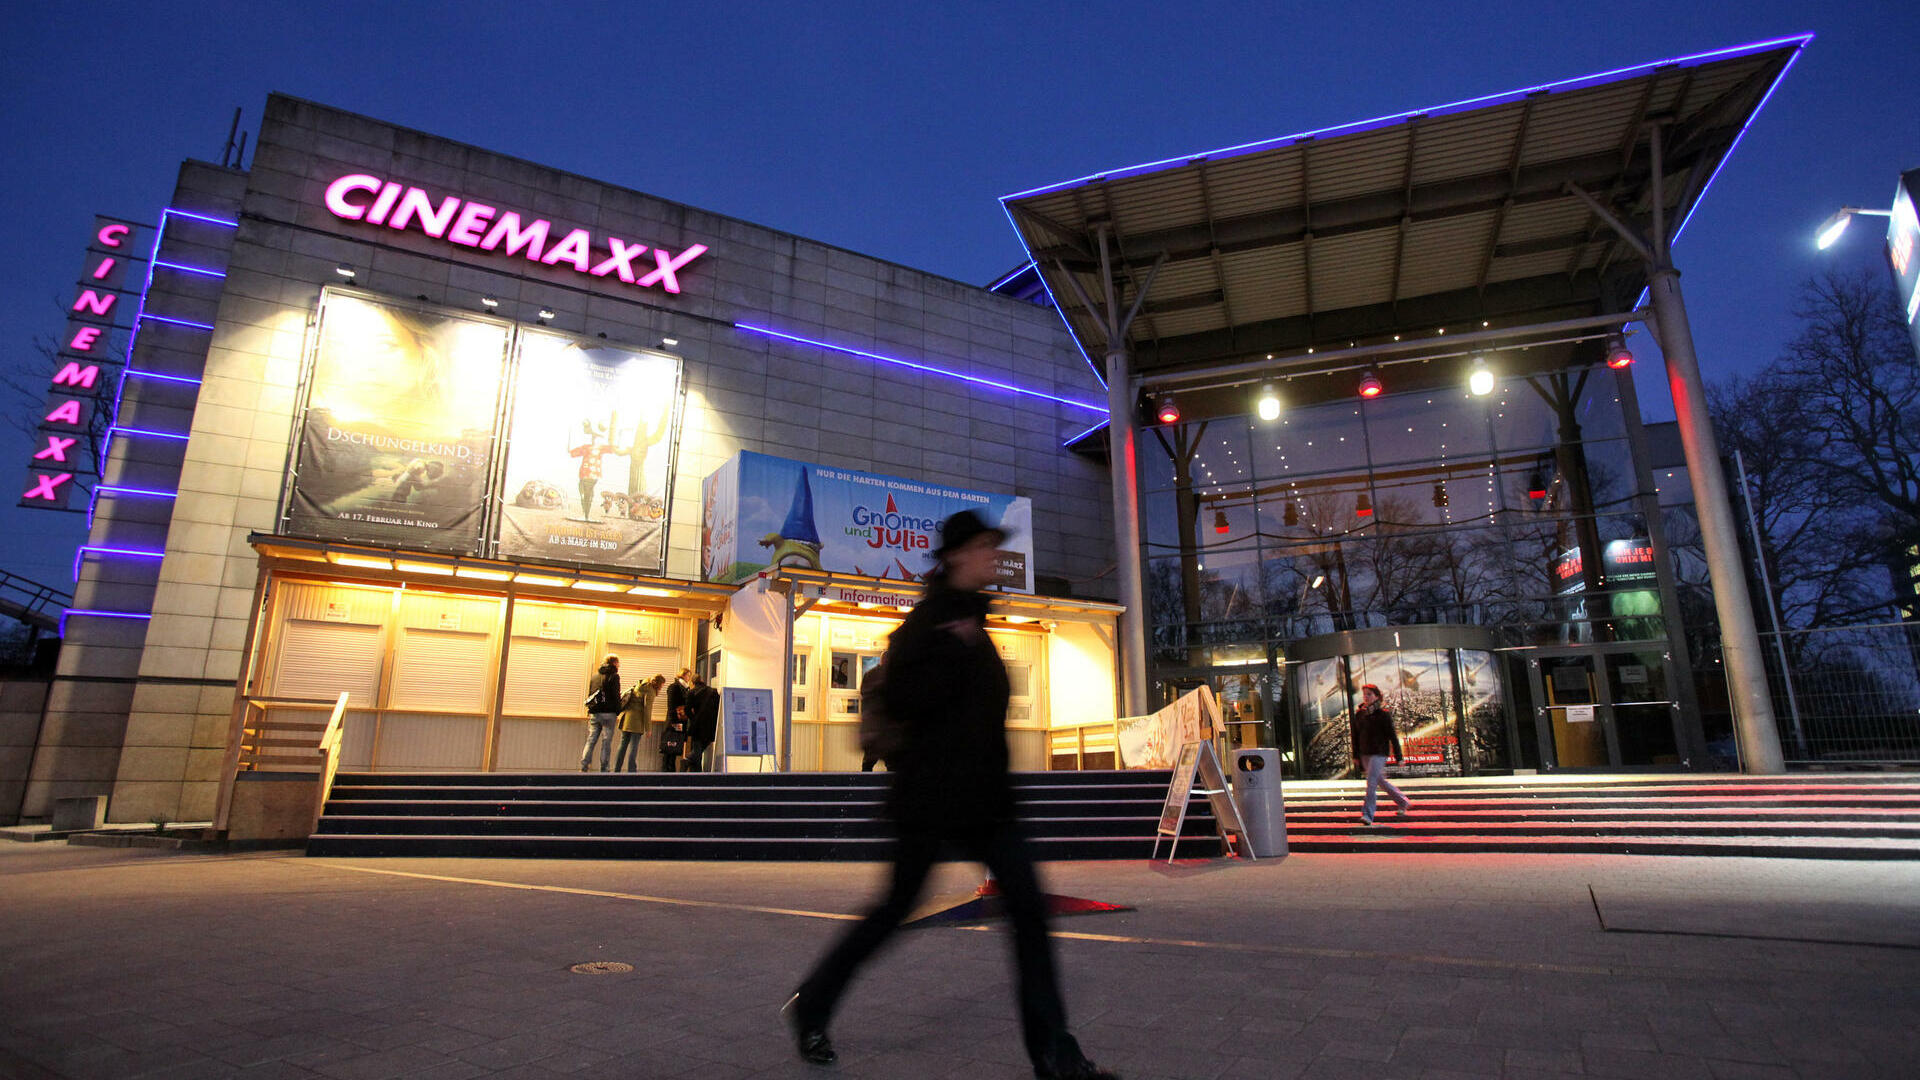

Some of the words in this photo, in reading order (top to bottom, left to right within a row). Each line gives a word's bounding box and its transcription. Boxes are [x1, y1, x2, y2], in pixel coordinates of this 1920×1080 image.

[325, 174, 709, 294] CINEMAXX
[23, 224, 130, 501] CINEMAXX
[327, 427, 470, 458] DSCHUNGELKIND
[816, 469, 835, 479] NUR
[837, 472, 851, 482] DIE
[887, 481, 924, 494] KOMMEN
[926, 487, 941, 496] AUS
[943, 489, 960, 499] DEM
[961, 492, 990, 504] GARTEN
[352, 513, 364, 521] 17.
[548, 535, 559, 544] AB
[589, 540, 599, 548] IM
[600, 541, 618, 550] KINO
[845, 526, 872, 538] und
[867, 526, 929, 552] Julia
[1003, 559, 1024, 570] MÄRZ
[840, 588, 914, 607] Information
